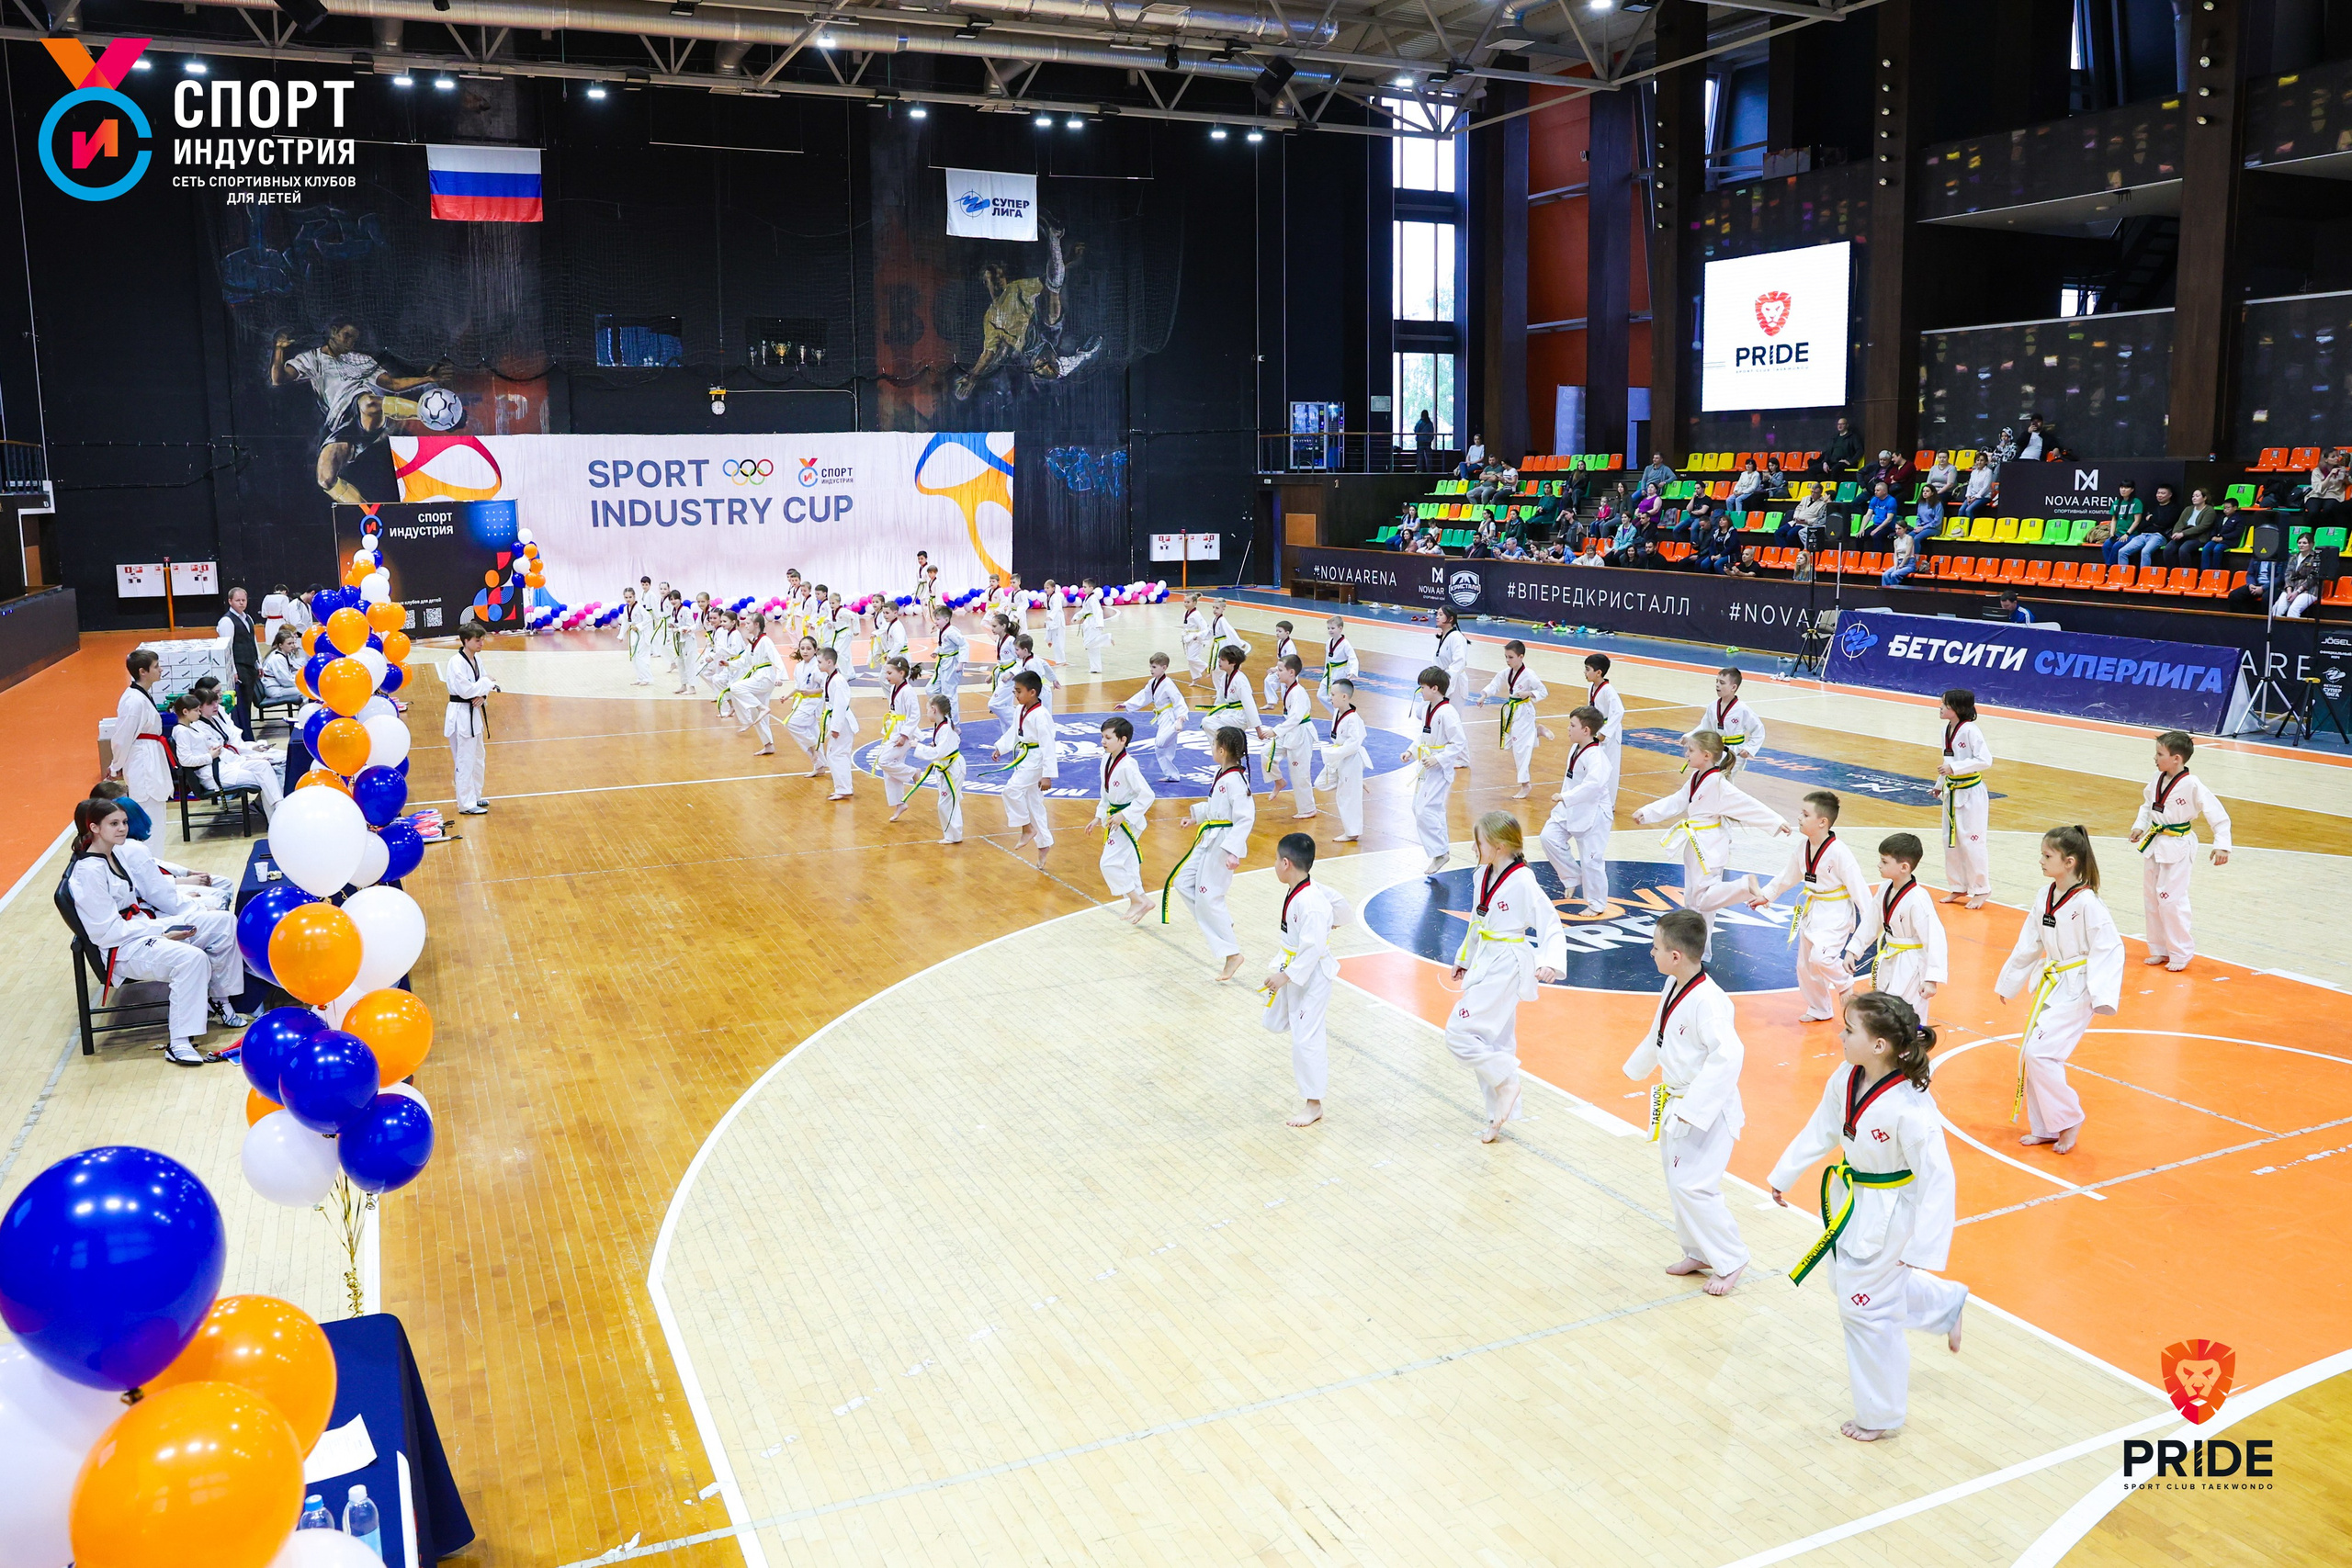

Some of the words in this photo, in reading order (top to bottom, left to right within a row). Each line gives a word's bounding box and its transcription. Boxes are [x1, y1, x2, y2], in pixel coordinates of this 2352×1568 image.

[991, 197, 1030, 209] СУПЕР
[991, 208, 1023, 218] ЛИГА
[1736, 342, 1809, 367] PRIDE
[588, 459, 710, 488] SPORT
[820, 468, 854, 478] СПОРТ
[2045, 495, 2079, 506] NOVA
[2083, 496, 2117, 507] AREN
[417, 512, 453, 525] спорт
[591, 497, 773, 527] INDUSTRY
[783, 495, 854, 524] CUP
[389, 525, 454, 540] индустрия
[1313, 564, 1397, 587] #NOVAARENA
[1418, 585, 1436, 593] NOVA
[1507, 581, 1690, 616] #ВПЕРЕДКРИСТАЛЛ
[2321, 637, 2352, 647] JÖGEL
[1888, 634, 2029, 671] БЕТСИТИ
[2033, 650, 2223, 694] СУПЕРЛИГА
[1802, 1228, 1837, 1269] TAEKWONDO
